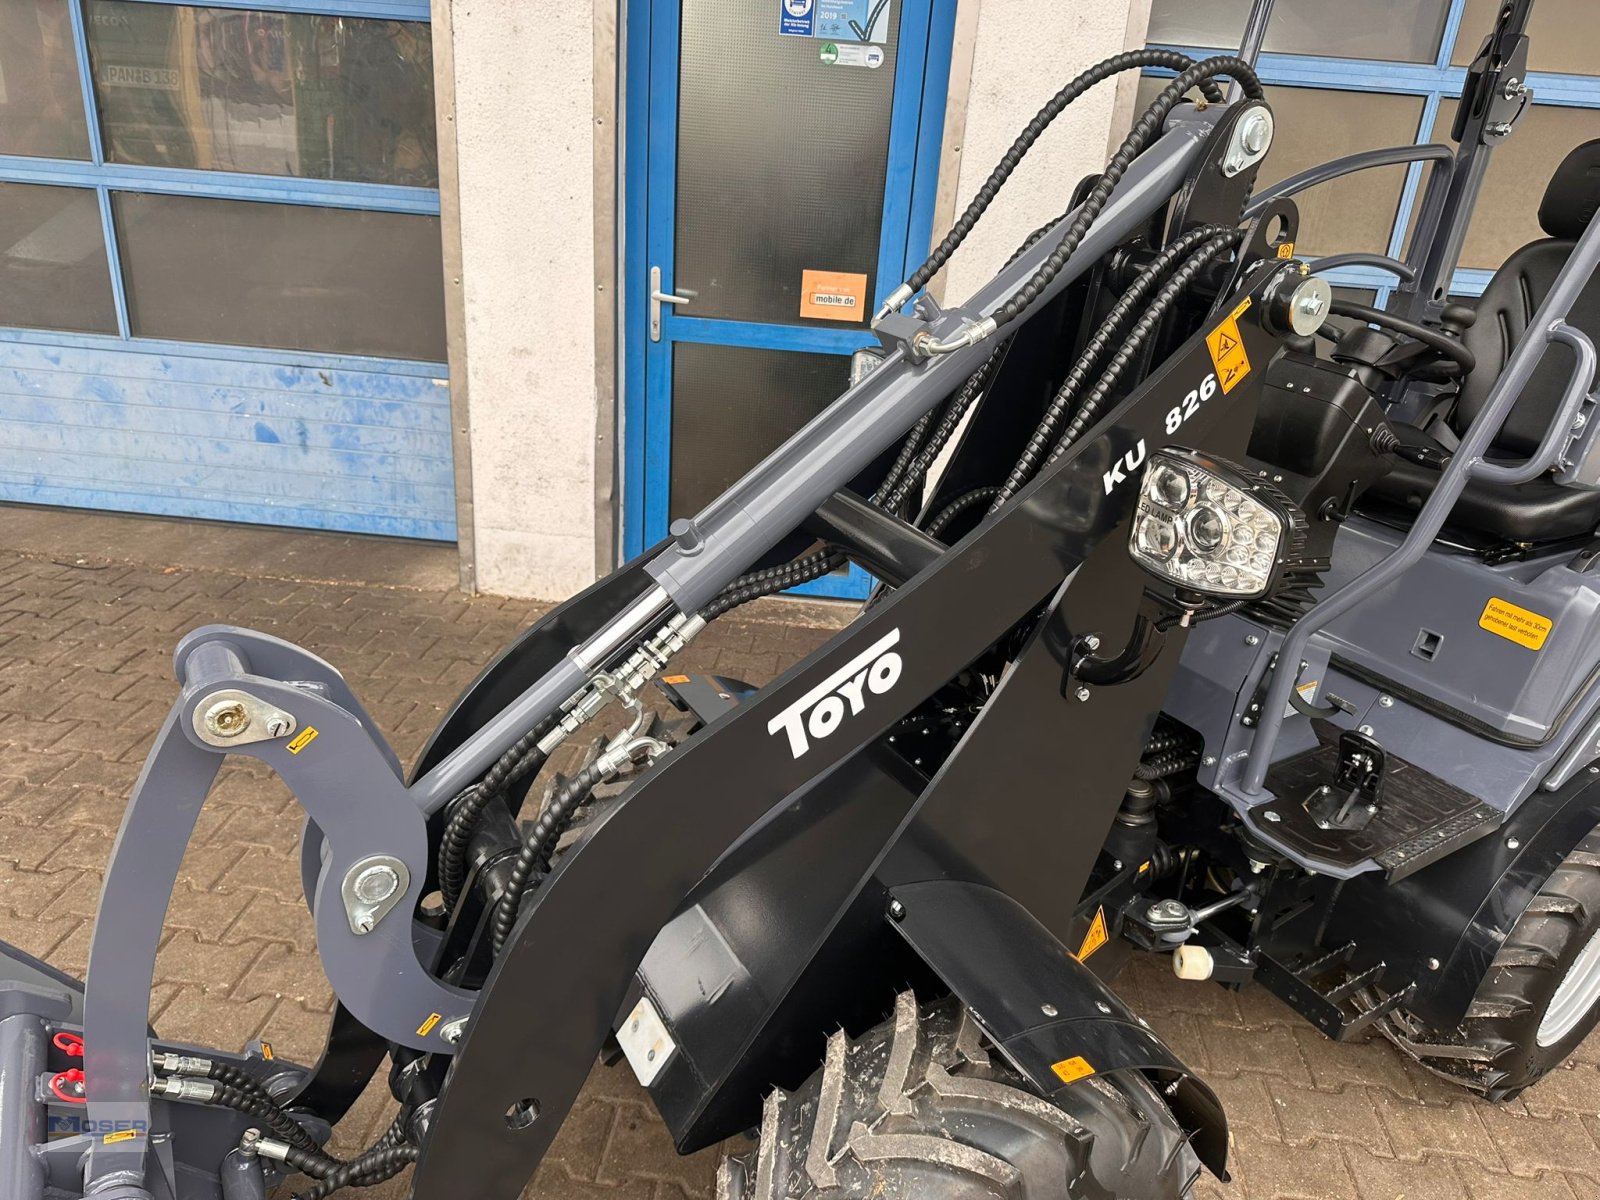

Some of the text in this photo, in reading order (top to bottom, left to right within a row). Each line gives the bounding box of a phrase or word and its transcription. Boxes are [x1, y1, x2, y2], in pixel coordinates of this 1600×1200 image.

[820, 11, 837, 20] 2019
[1102, 373, 1217, 496] KU 826
[1151, 507, 1173, 524] LAMP
[1488, 604, 1505, 616] Fahren
[1512, 615, 1526, 623] mehr
[1484, 614, 1509, 628] gehobener
[1517, 628, 1539, 640] verboten
[767, 627, 902, 759] TOYO
